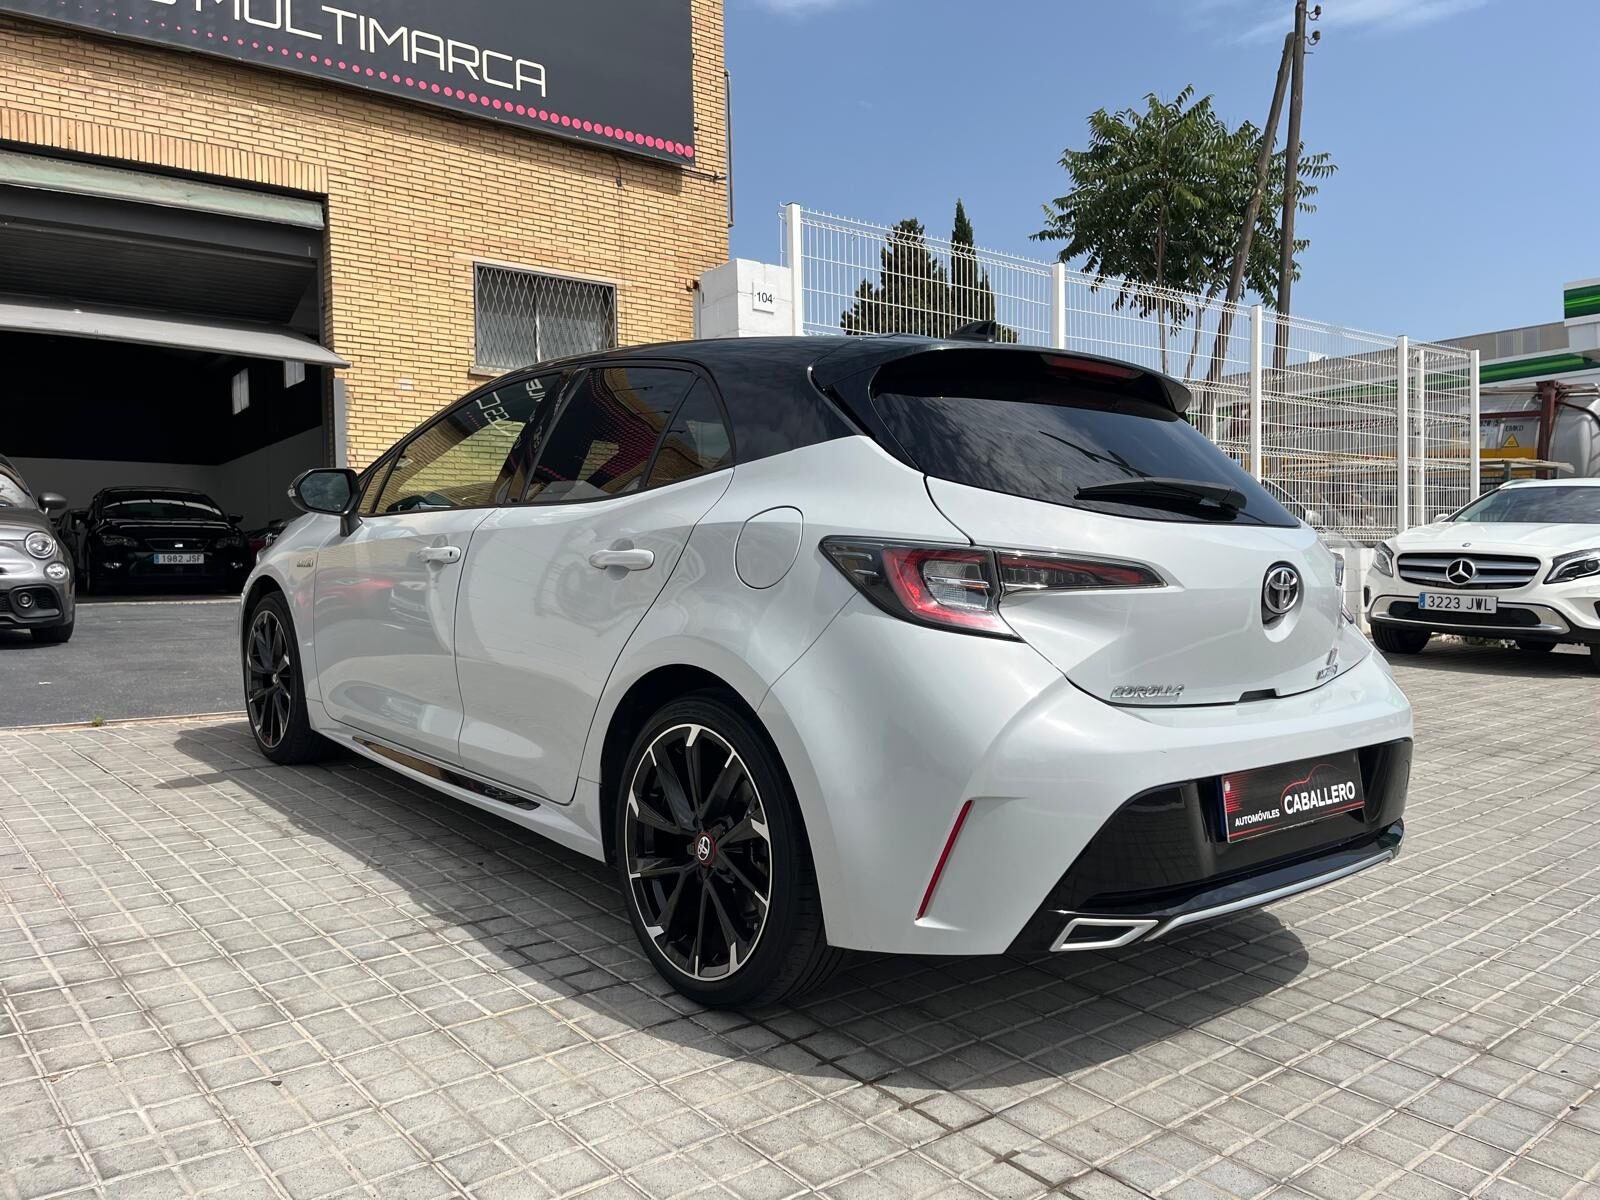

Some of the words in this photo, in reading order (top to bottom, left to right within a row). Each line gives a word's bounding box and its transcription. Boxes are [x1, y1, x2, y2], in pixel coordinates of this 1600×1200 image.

[757, 291, 773, 304] 104
[162, 554, 184, 563] 1982
[1428, 595, 1461, 609] 3223
[1466, 597, 1492, 611] JWL
[1110, 684, 1185, 698] COROLLA
[1235, 808, 1280, 827] AUTOMÓVILES
[1284, 781, 1356, 815] CABALLERO
